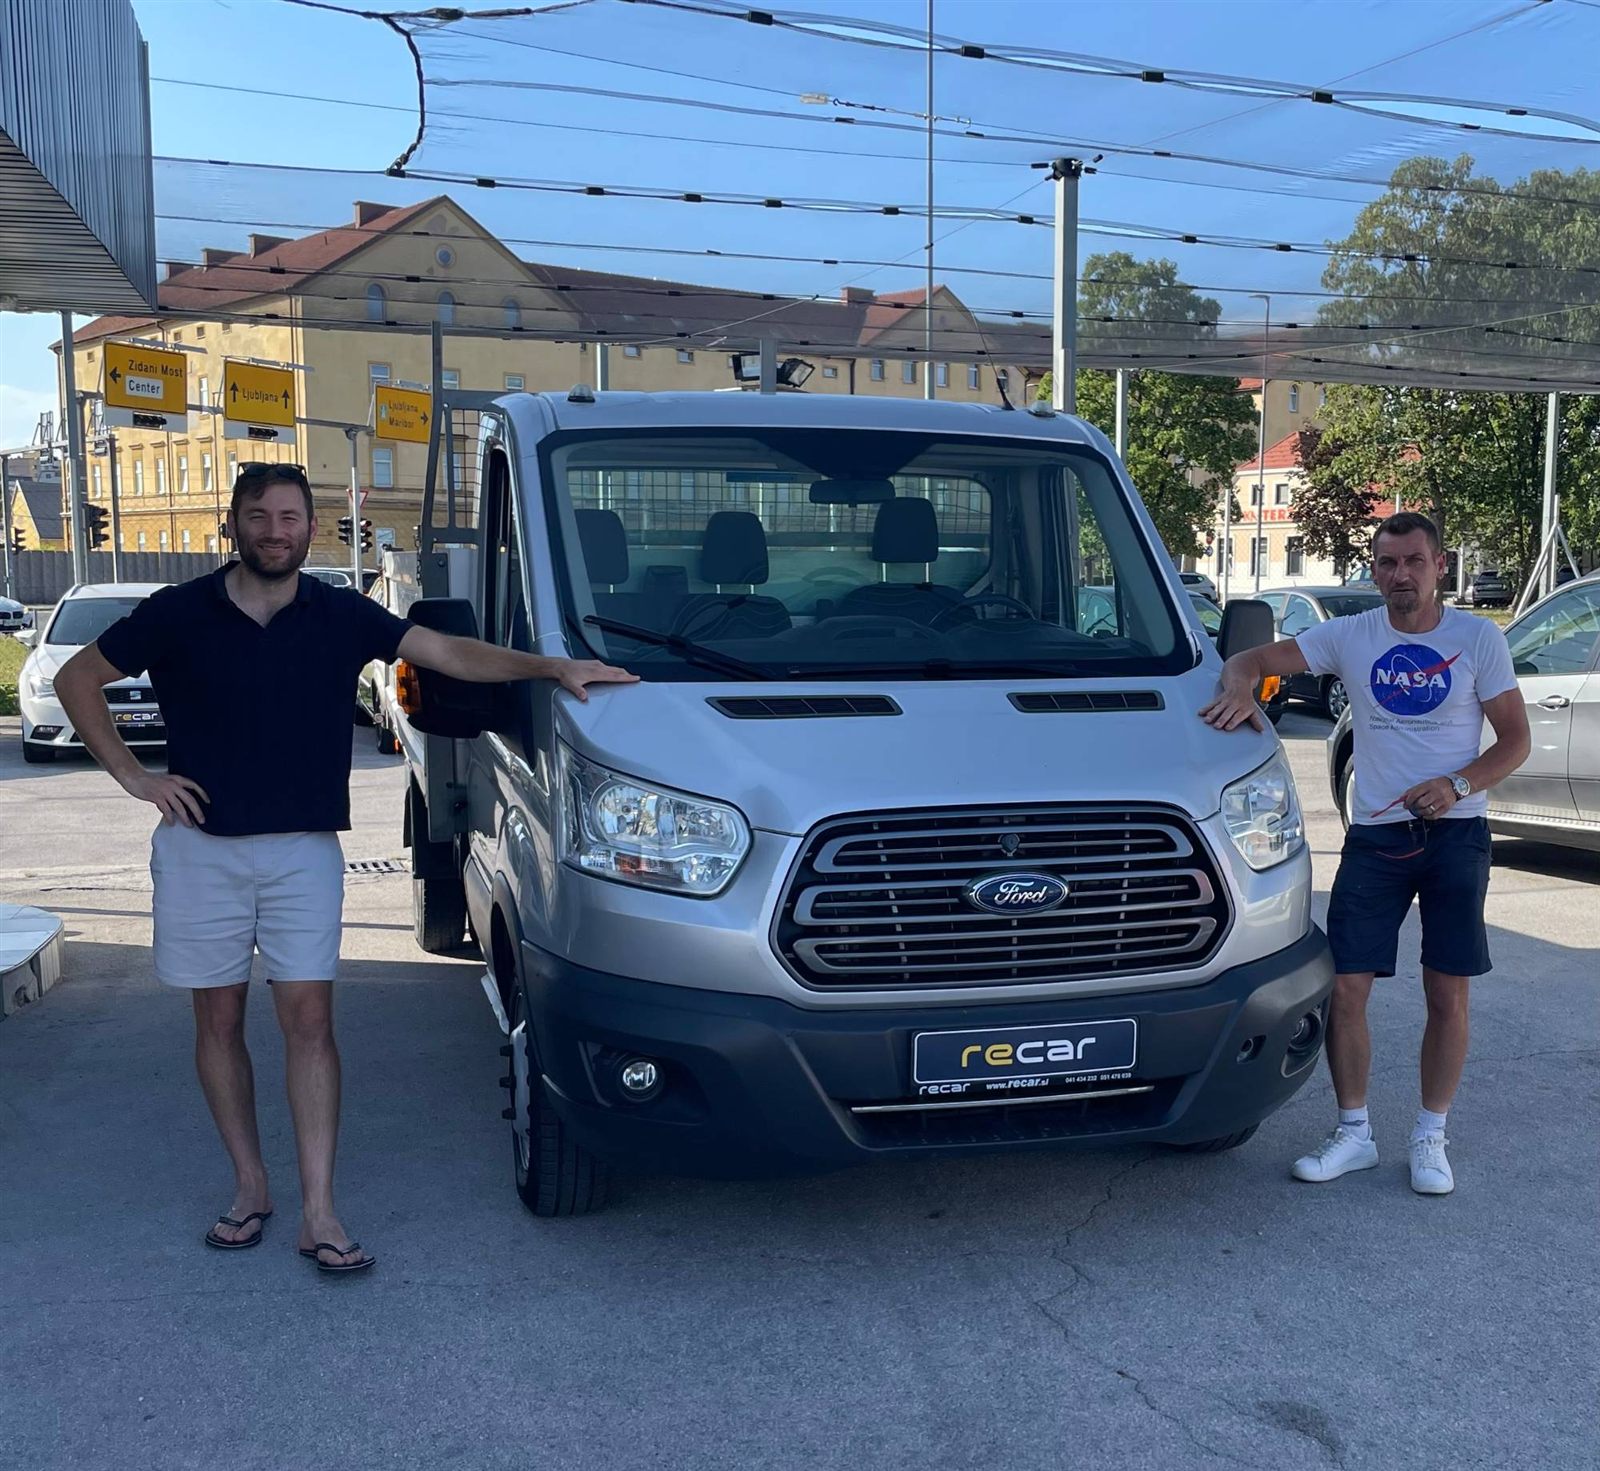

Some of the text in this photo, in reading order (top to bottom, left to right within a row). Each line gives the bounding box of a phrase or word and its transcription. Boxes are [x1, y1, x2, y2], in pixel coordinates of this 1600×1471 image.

[128, 359, 183, 378] Zidani Most
[128, 379, 161, 394] Center
[242, 388, 279, 403] Ljubljana
[388, 399, 418, 413] Ljubljana
[389, 416, 415, 429] Maribor
[1376, 668, 1446, 688] NASA
[115, 713, 158, 721] recar
[994, 881, 1048, 905] Ford
[961, 1037, 1097, 1068] recar
[919, 1082, 971, 1095] recar
[985, 1077, 1050, 1090] www.recar.si
